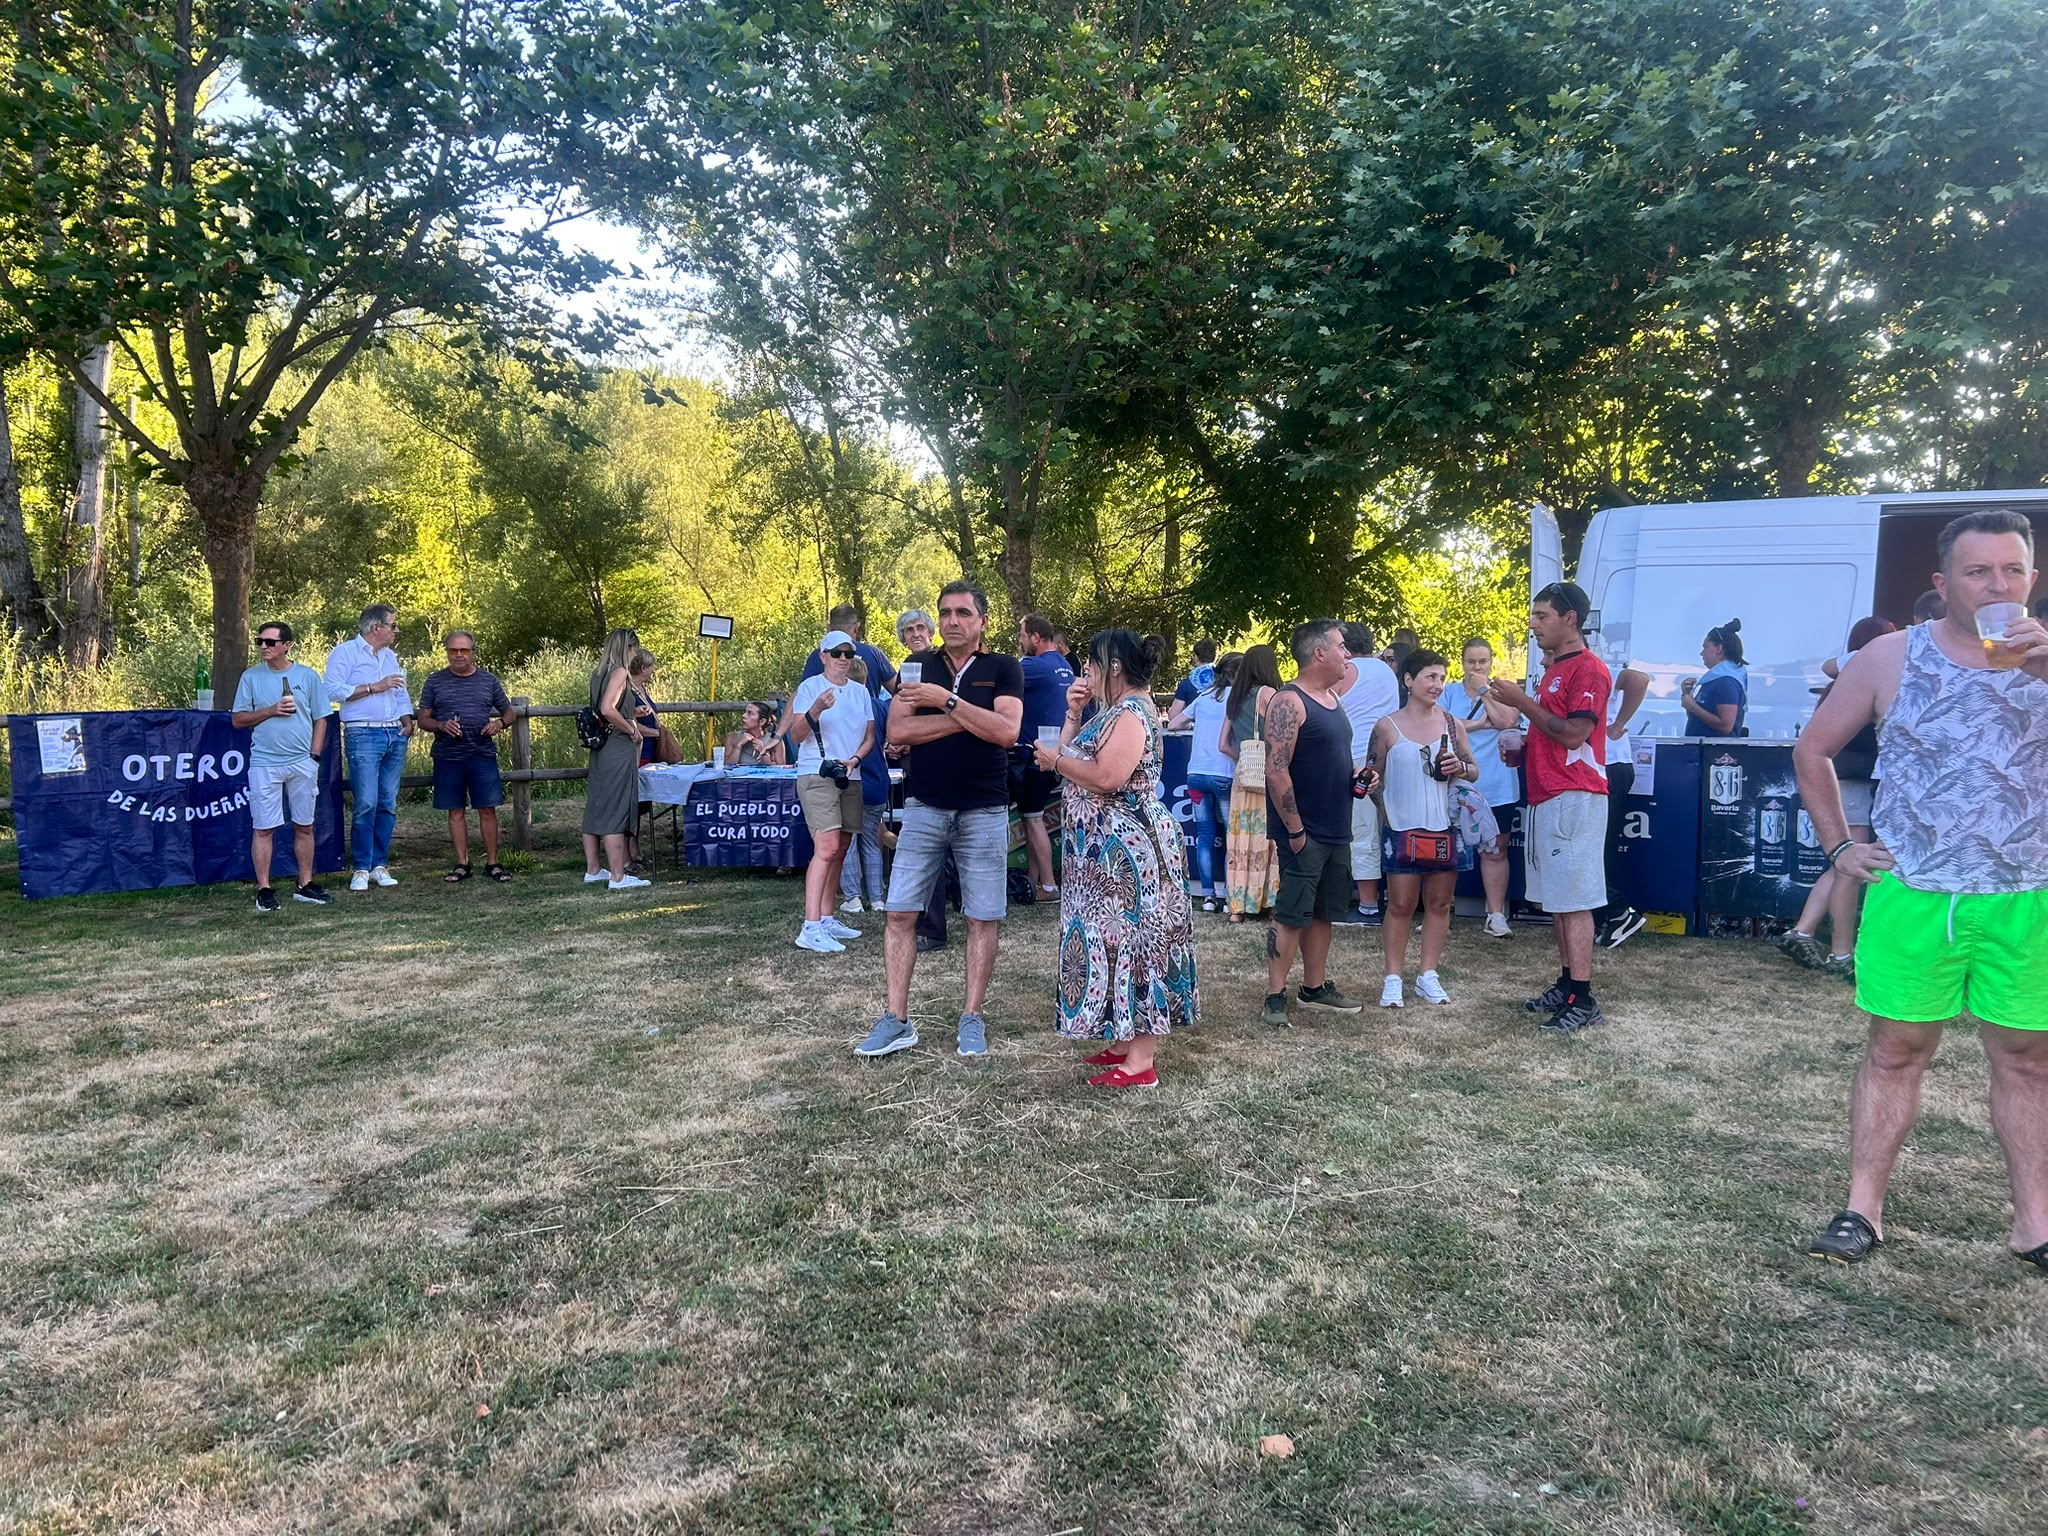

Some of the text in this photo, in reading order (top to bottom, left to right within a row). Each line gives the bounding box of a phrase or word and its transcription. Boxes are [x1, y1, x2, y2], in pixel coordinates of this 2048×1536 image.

[122, 749, 244, 783] OTERO
[107, 789, 137, 812] DE
[139, 801, 177, 822] LAS
[696, 803, 801, 818] EL PUEBLO LO
[708, 826, 790, 840] CURA TODO
